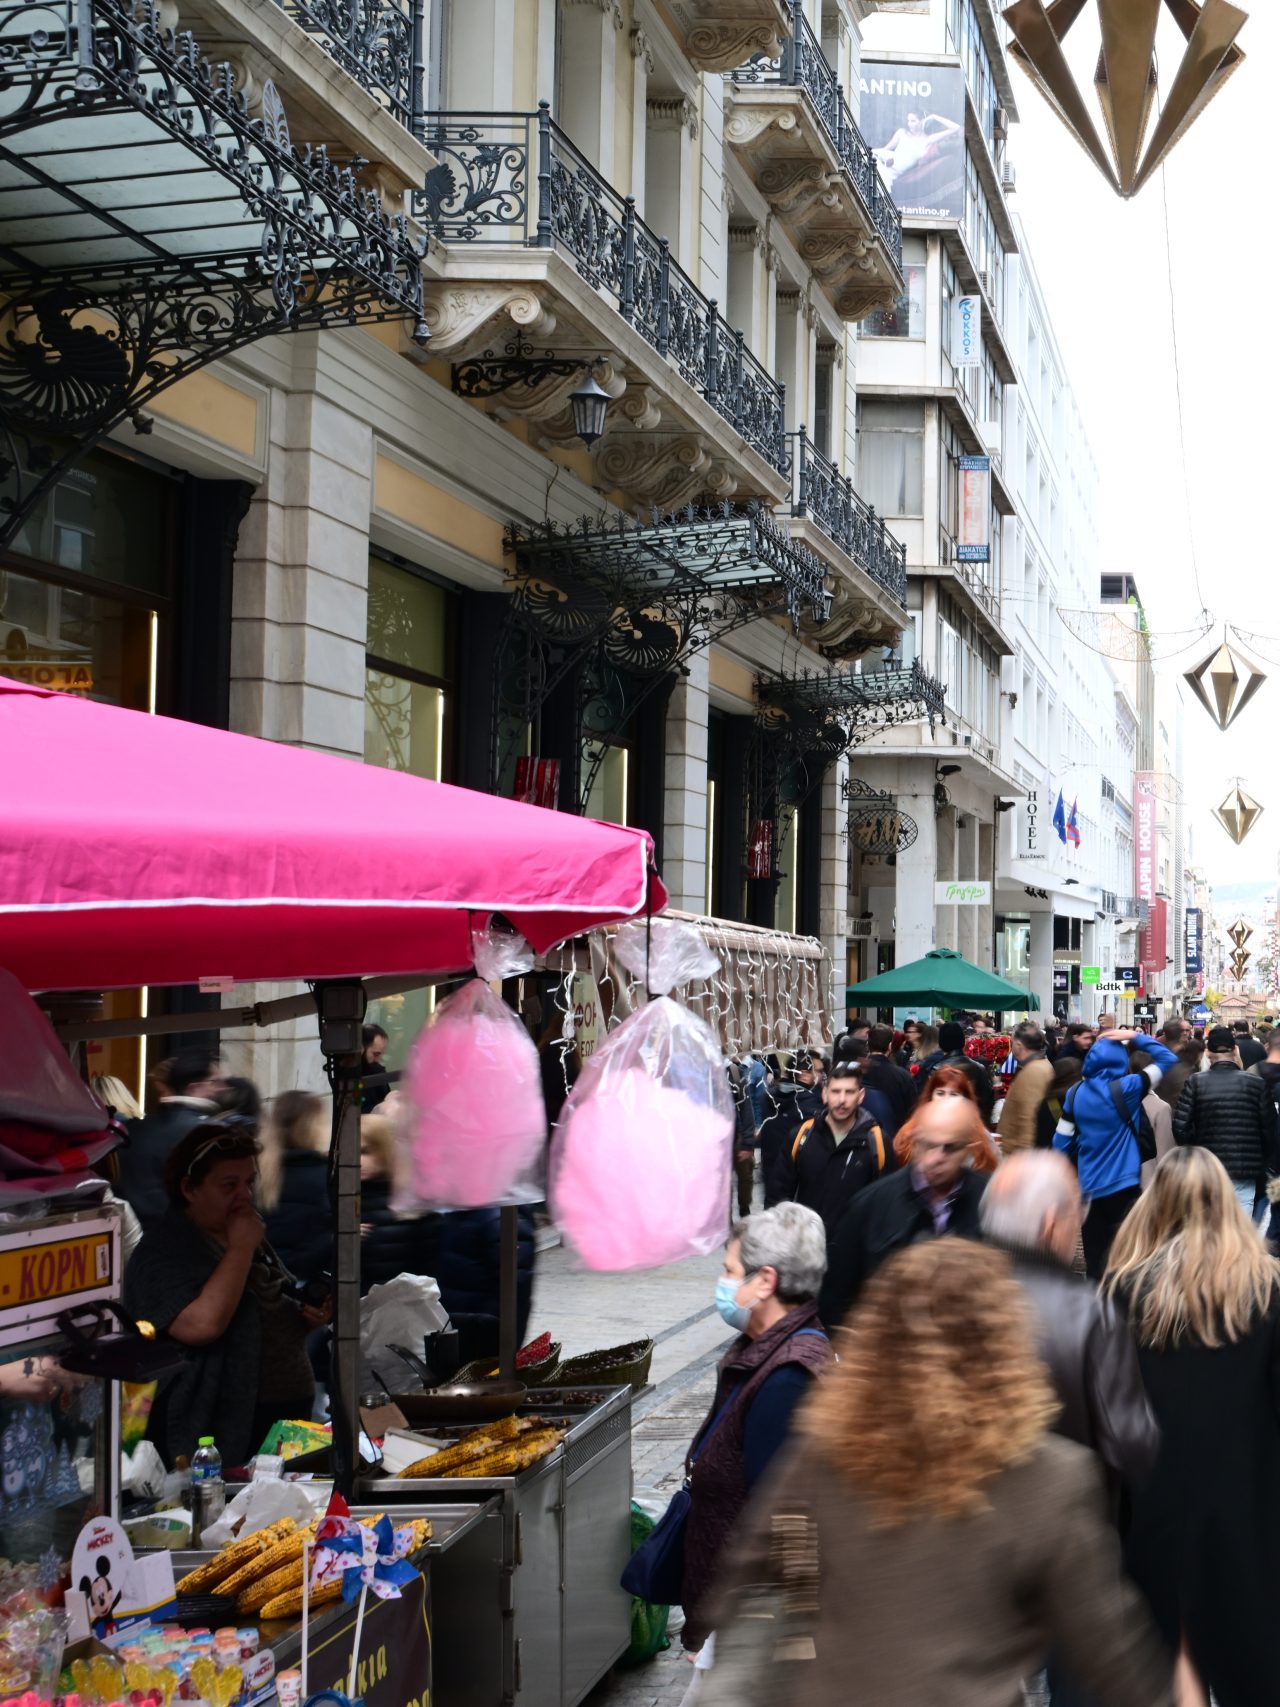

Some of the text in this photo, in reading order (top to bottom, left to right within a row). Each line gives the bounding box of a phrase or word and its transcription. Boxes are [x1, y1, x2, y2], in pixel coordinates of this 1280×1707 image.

[1027, 790, 1038, 850] HOTEL
[1139, 802, 1152, 851] HOUSE
[1096, 982, 1121, 991] Bdtk
